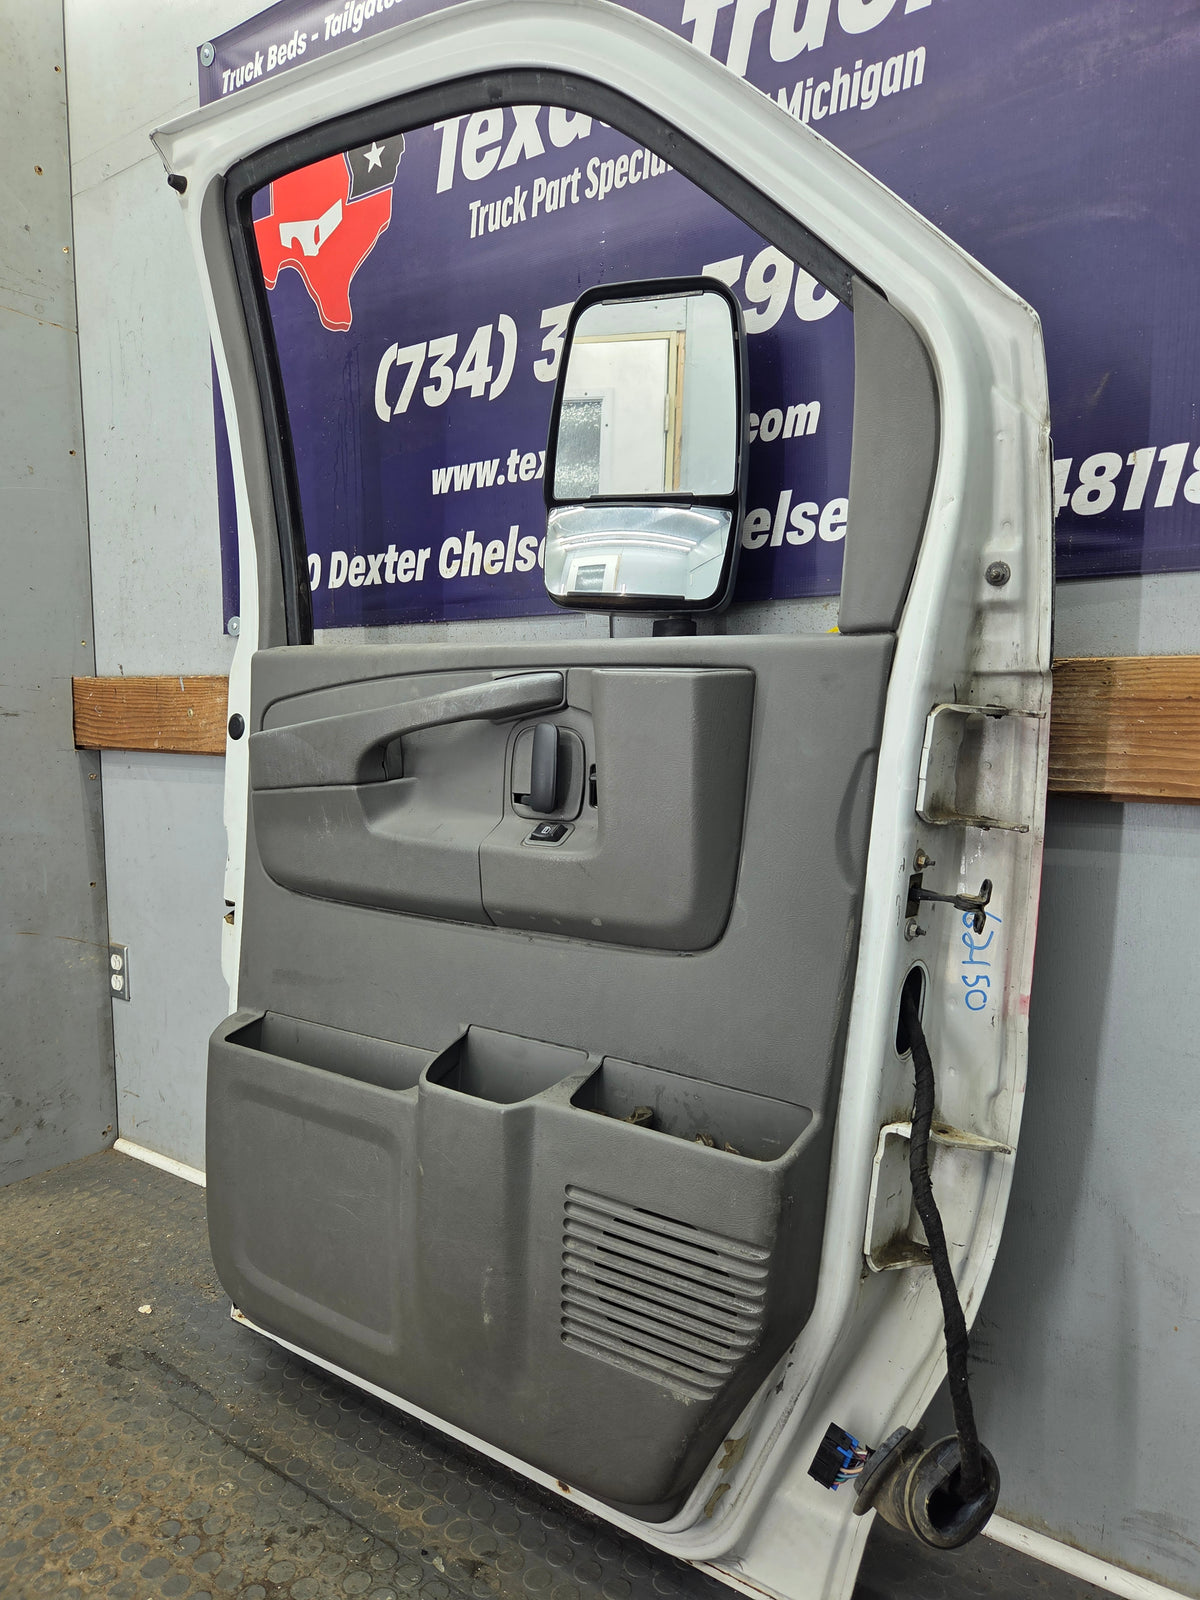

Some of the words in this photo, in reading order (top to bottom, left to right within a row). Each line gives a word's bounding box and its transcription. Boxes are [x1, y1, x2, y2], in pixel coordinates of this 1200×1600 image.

[222, 50, 264, 95] Truck
[267, 30, 308, 71] Beds
[776, 46, 926, 124] Michigan
[433, 105, 611, 194] Texa
[469, 185, 529, 239] Truck
[531, 167, 582, 218] Part
[584, 147, 675, 201] Specia
[374, 313, 518, 423] (734)
[328, 544, 431, 589] Dexter
[438, 525, 546, 580] Chels
